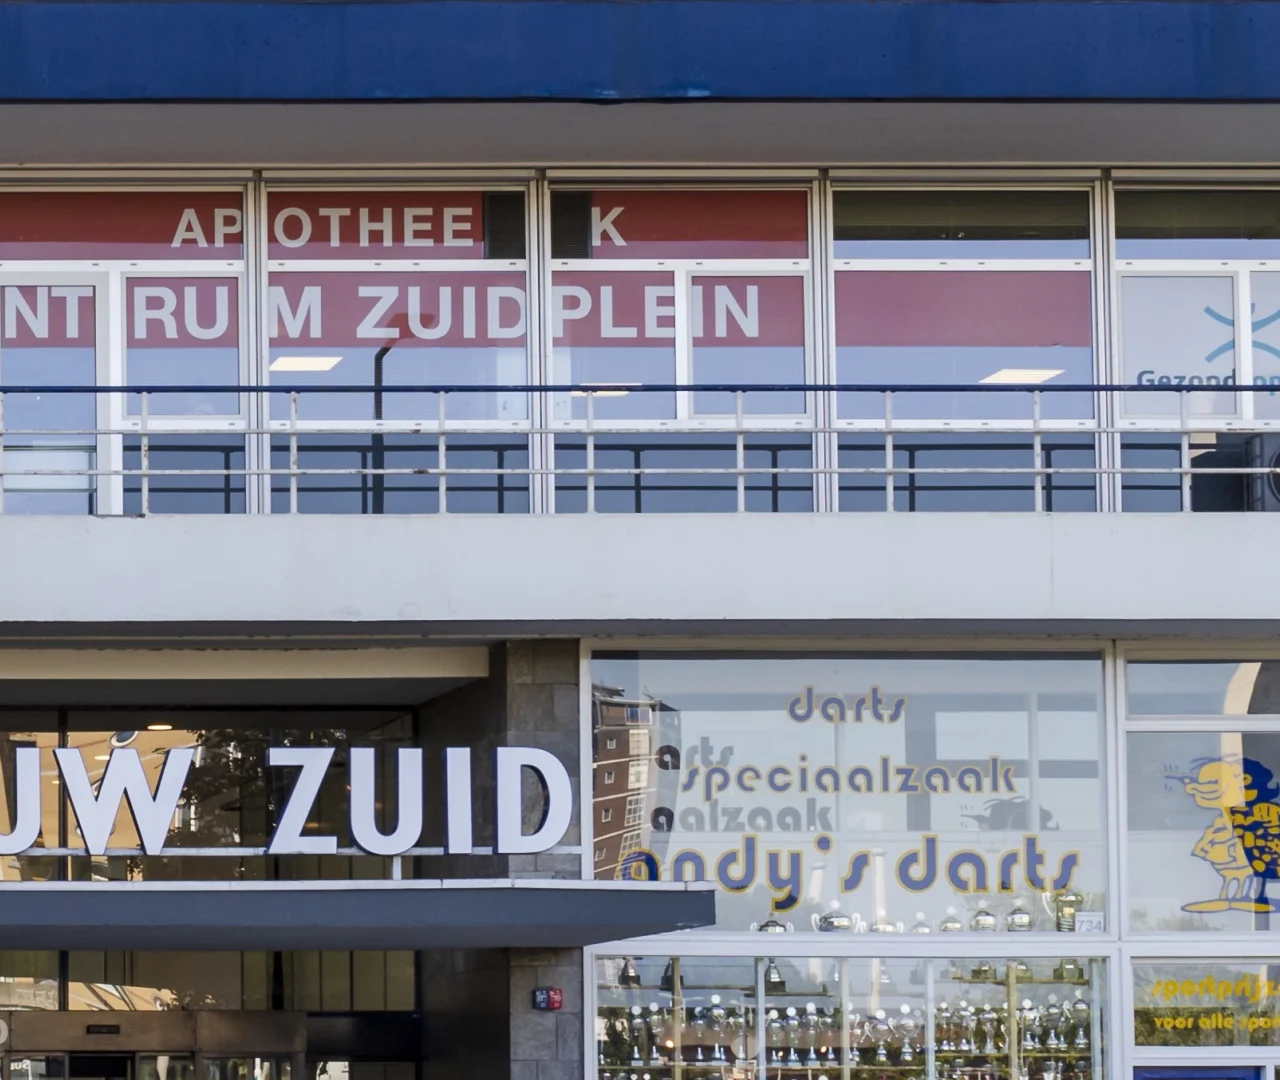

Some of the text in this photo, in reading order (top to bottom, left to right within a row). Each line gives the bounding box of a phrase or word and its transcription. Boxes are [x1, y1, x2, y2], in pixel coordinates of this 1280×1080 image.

[787, 684, 907, 724] darts
[680, 754, 1018, 803] speciaalzaak
[268, 746, 572, 855] ZUID
[615, 833, 1081, 913] andy's darts
[1077, 918, 1102, 932] 734
[1151, 974, 1280, 1004] sportprijz
[1154, 1015, 1194, 1031] voor
[1198, 1012, 1234, 1030] alle
